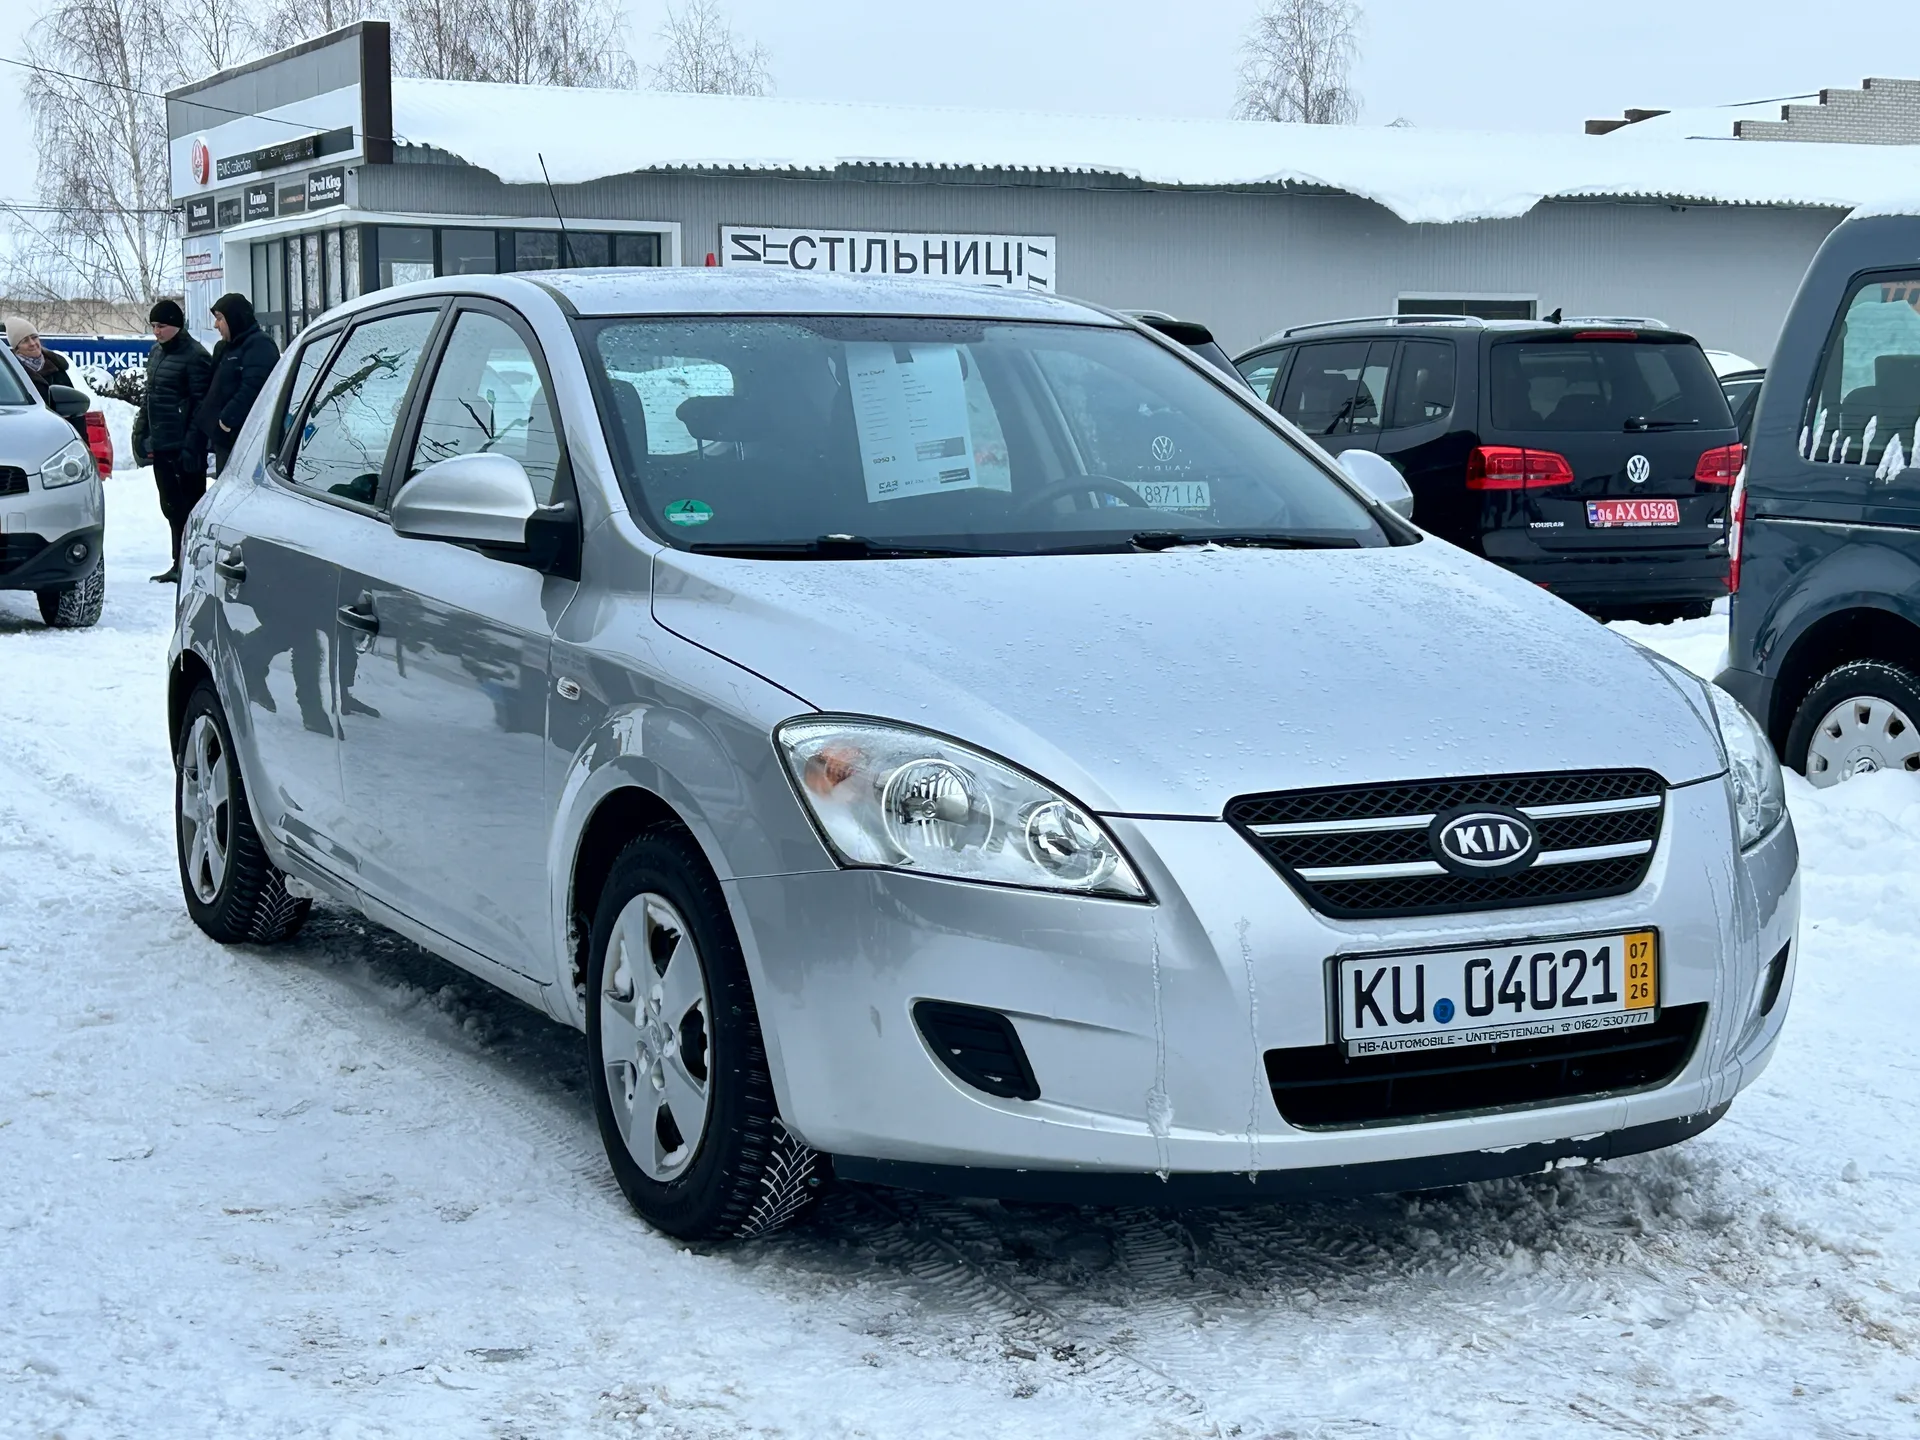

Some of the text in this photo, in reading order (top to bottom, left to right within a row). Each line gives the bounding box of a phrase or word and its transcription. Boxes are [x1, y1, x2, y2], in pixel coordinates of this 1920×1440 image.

[789, 236, 1023, 284] СТІЛЬНИЦІ
[1187, 485, 1205, 504] IA
[681, 500, 695, 513] 4
[1597, 503, 1675, 521] 06 AX 0528
[1454, 823, 1521, 855] KIA
[1629, 942, 1649, 960] 07
[1629, 963, 1649, 980] 02
[1353, 946, 1618, 1029] KU 04021
[1630, 983, 1649, 1000] 26
[1358, 1011, 1649, 1053] HB-AUTOMOBILE UNTERSTEINACH 0162/5307777
